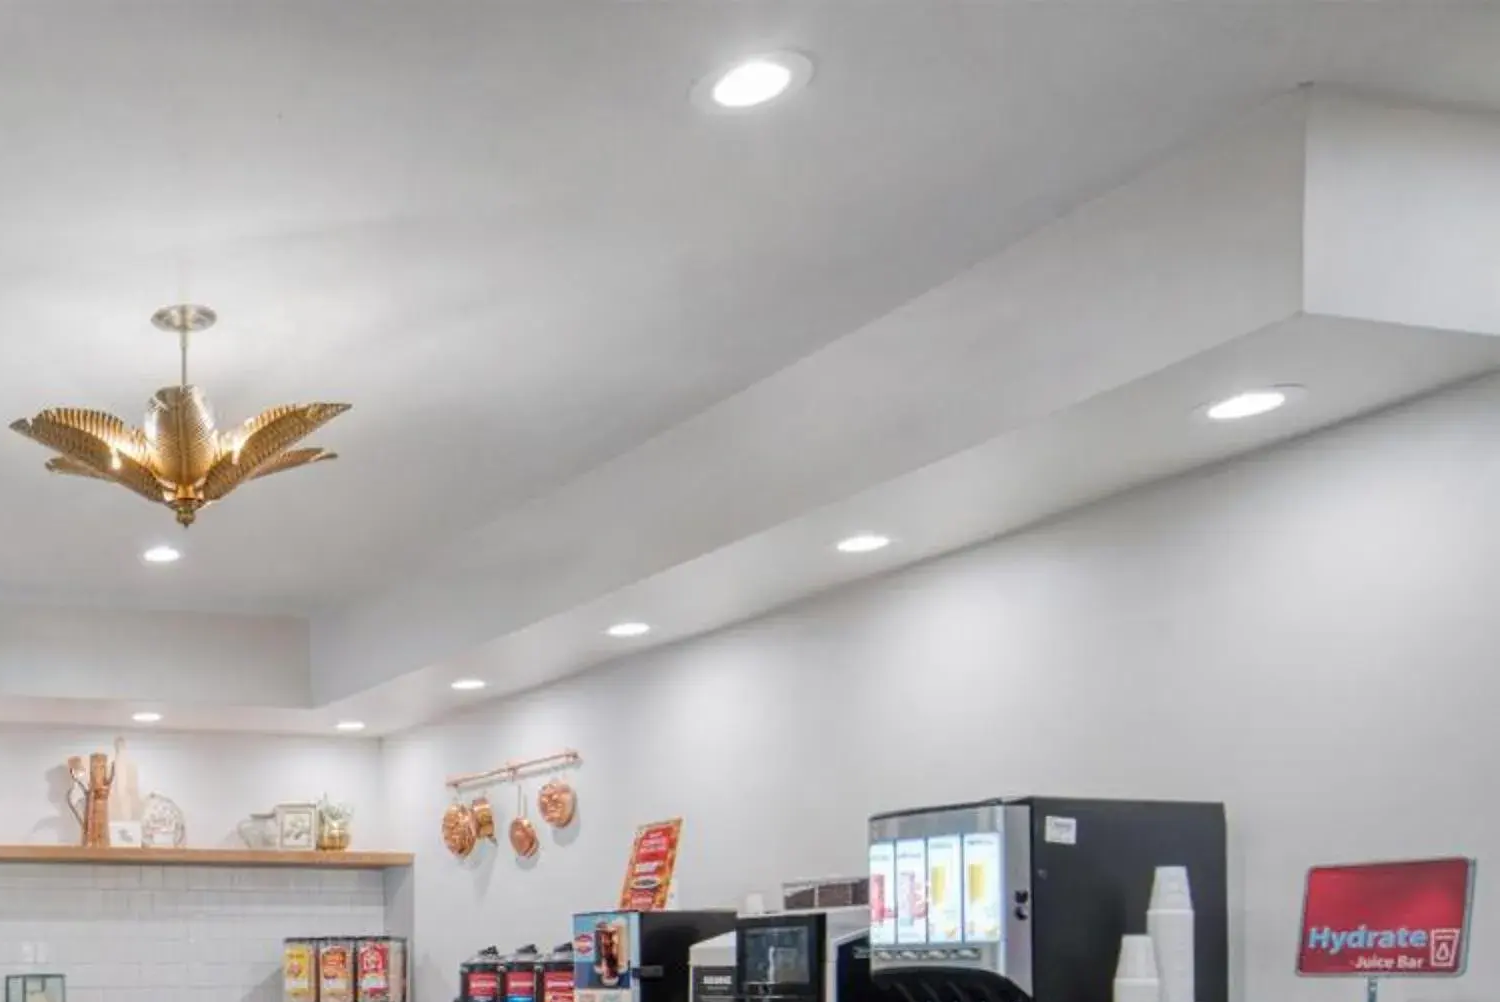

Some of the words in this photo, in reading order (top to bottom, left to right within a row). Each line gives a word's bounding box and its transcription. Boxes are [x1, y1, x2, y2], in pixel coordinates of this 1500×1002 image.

[1308, 924, 1428, 955] Hydrate
[1354, 955, 1396, 969] Juice
[1397, 955, 1424, 969] Bar
